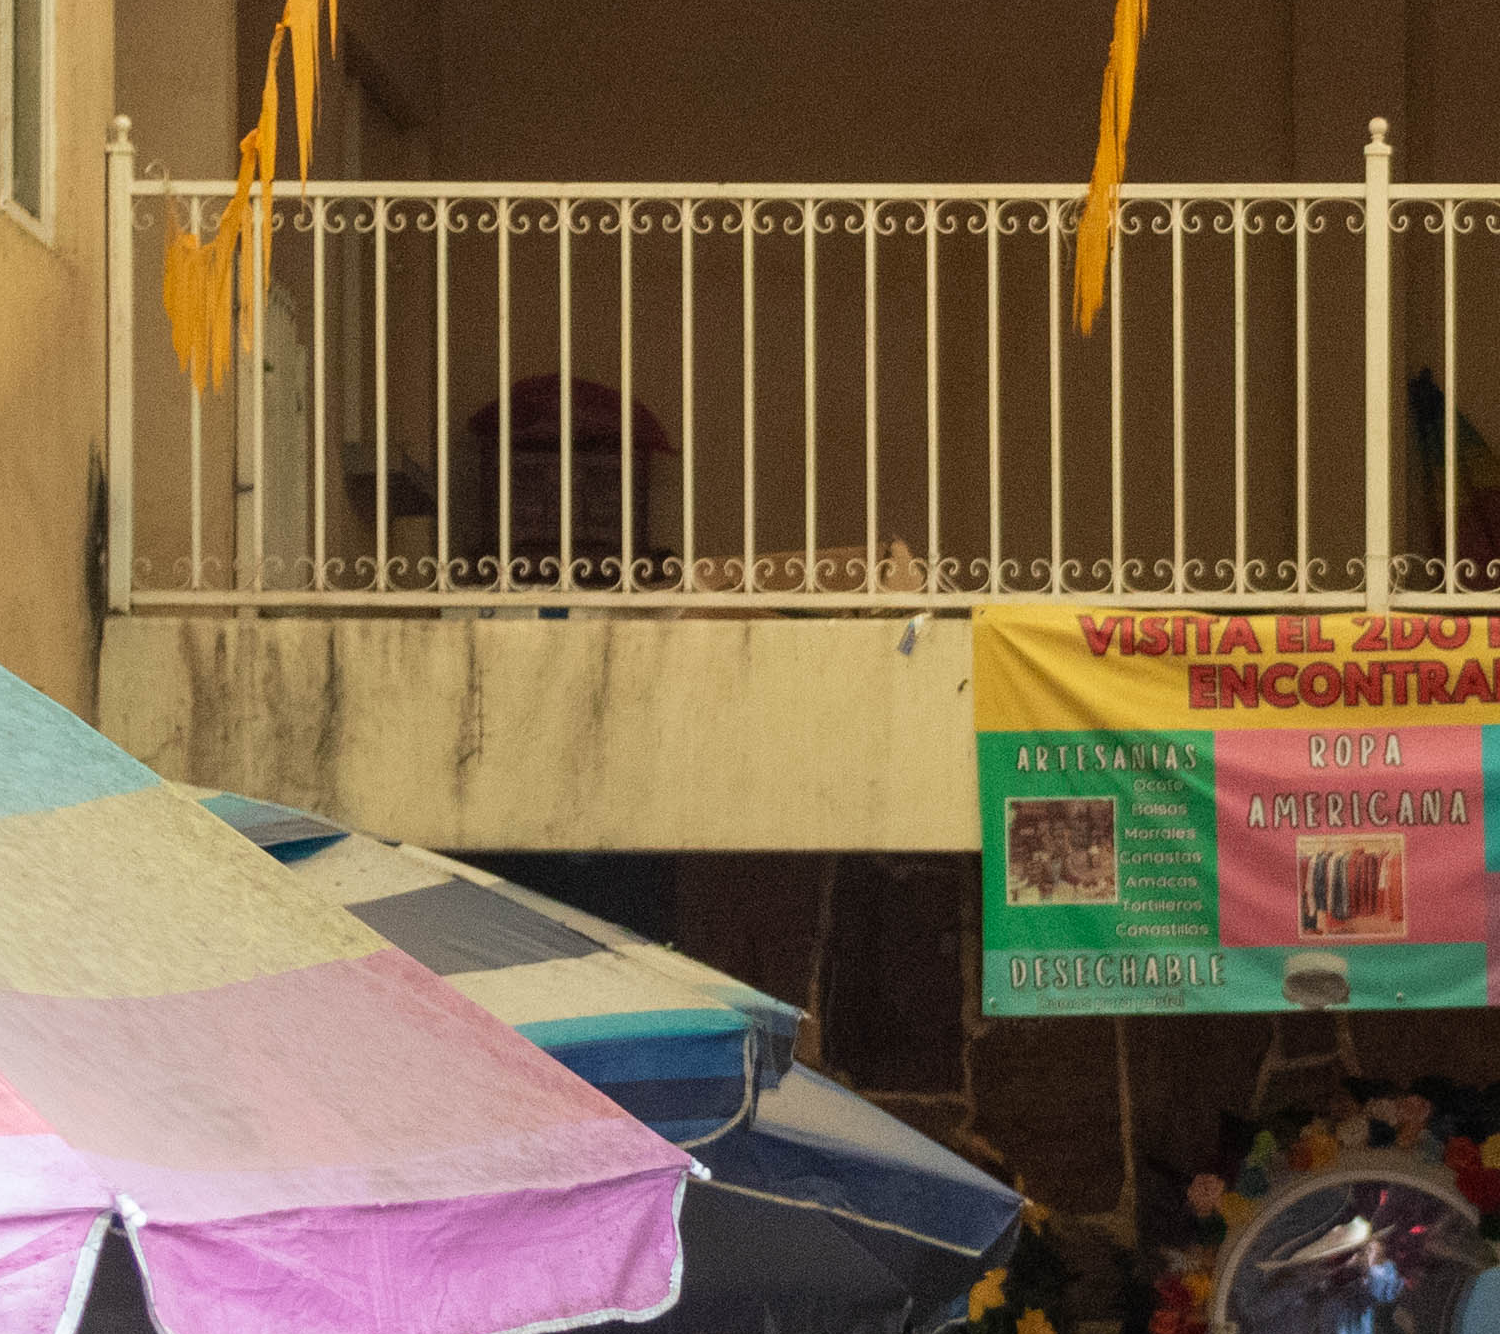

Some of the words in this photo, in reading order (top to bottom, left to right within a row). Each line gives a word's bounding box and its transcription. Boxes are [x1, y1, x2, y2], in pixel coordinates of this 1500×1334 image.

[1079, 614, 1262, 656] VISITA
[1276, 615, 1335, 653] EL
[1351, 615, 1471, 653] 2DO
[1017, 743, 1198, 772] ARTESANIAS
[1308, 732, 1401, 768] ROPA
[1248, 788, 1469, 829] AMERICANA
[1124, 827, 1197, 840] Morrales
[1120, 851, 1203, 865] Canastas
[1011, 953, 1227, 990] DESECHABLE
